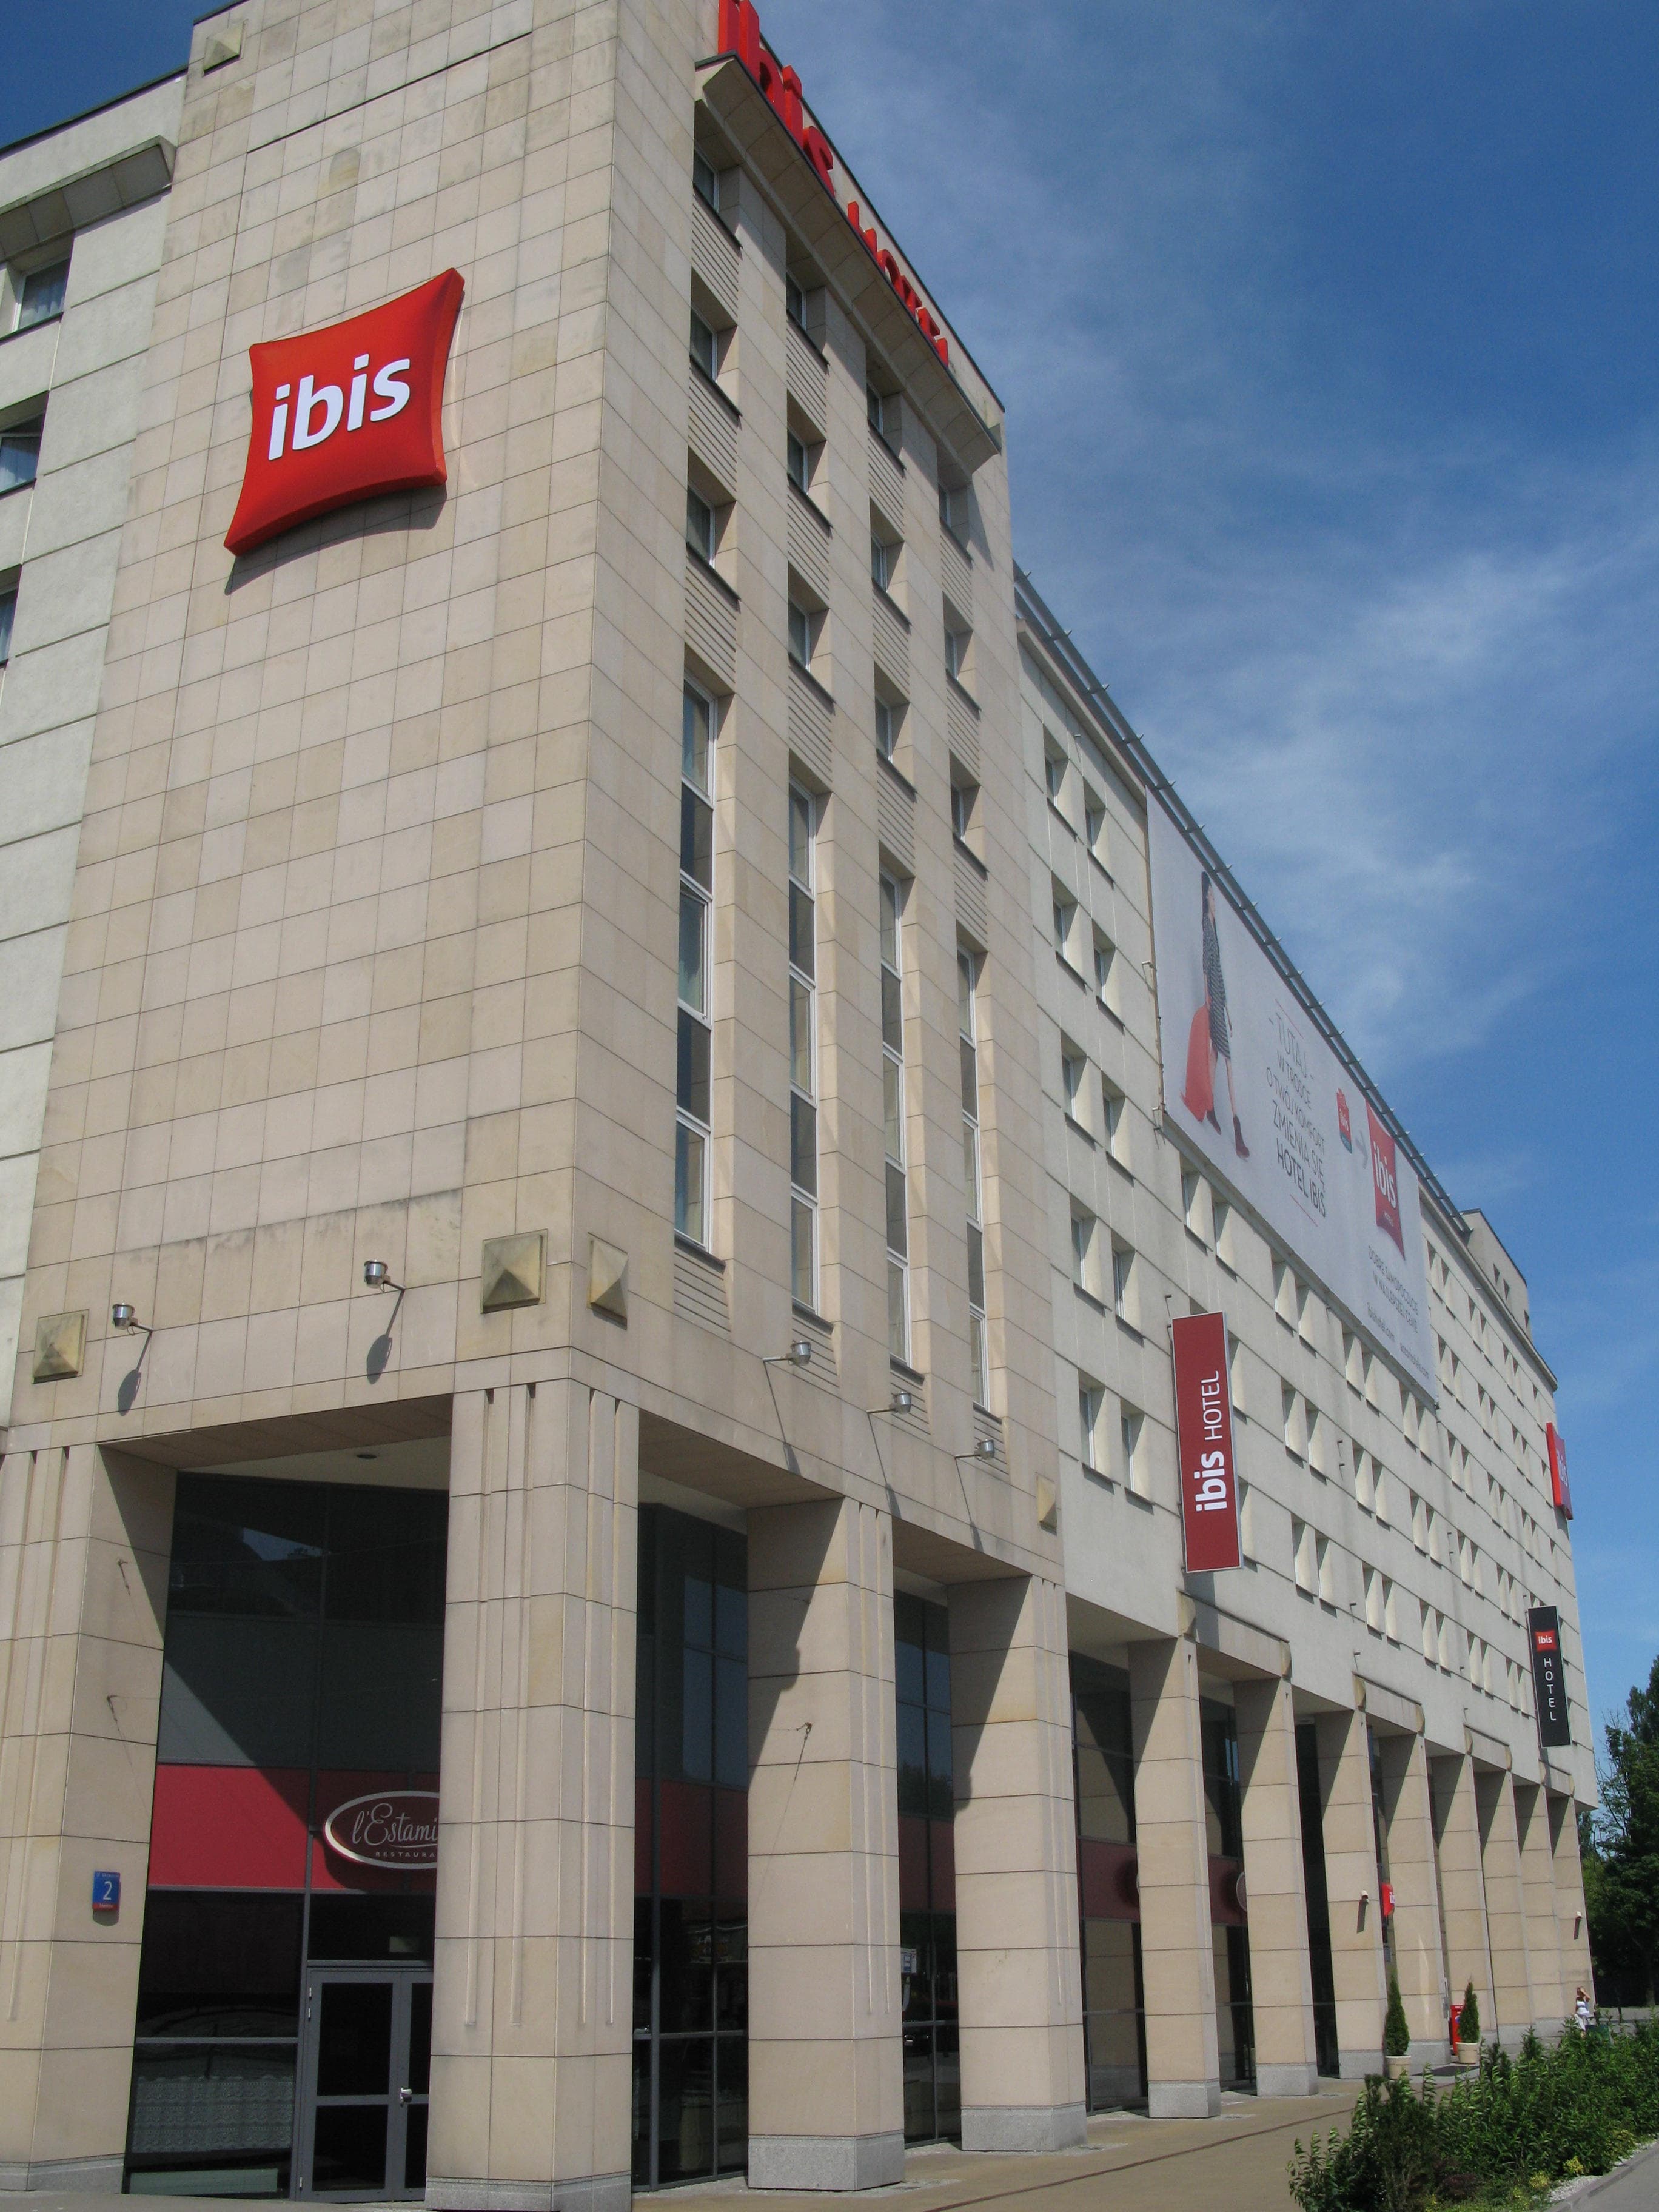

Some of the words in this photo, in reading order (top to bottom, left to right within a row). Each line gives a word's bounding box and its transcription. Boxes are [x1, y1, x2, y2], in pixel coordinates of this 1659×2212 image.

[269, 354, 411, 460] ibis
[1276, 1012, 1307, 1078] TUTAJ
[1272, 1099, 1310, 1168] ZMIENIA
[1276, 1138, 1309, 1198] HOTEL
[1309, 1178, 1326, 1218] IBIS
[1373, 1141, 1396, 1208] ibis
[1201, 1370, 1223, 1441] HOTEL
[1194, 1450, 1227, 1512] ibis
[1538, 1635, 1553, 1644] ibis
[1543, 1657, 1557, 1721] HOTEL
[102, 1880, 112, 1901] 2
